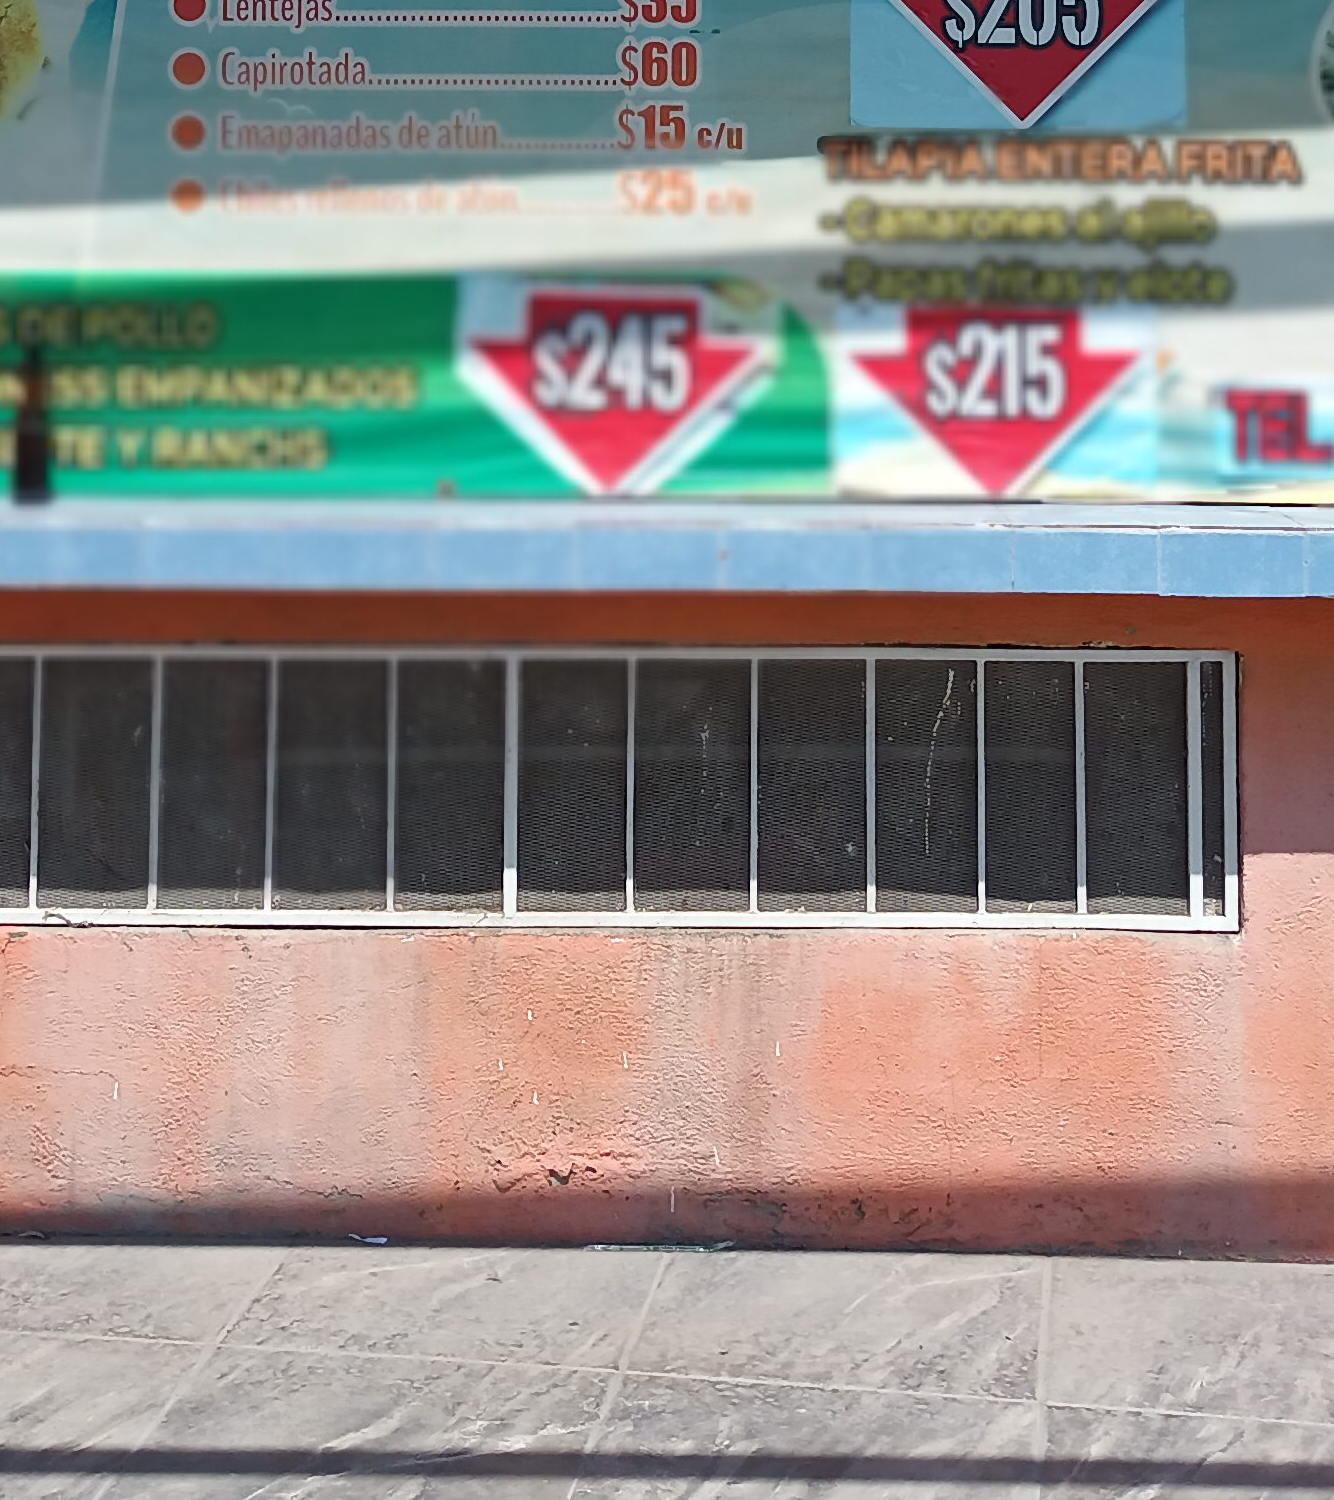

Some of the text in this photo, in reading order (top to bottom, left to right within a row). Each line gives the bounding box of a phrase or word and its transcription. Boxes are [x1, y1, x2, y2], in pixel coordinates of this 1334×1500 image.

[621, 40, 699, 88] $60
[220, 116, 391, 157] Emapanadas
[398, 116, 426, 150] de
[617, 104, 686, 150] $15
[697, 125, 744, 151] c/u
[824, 137, 1304, 184] TILAPIA ENTERA FRITA
[529, 308, 694, 414] $245
[922, 320, 1067, 420] $215
